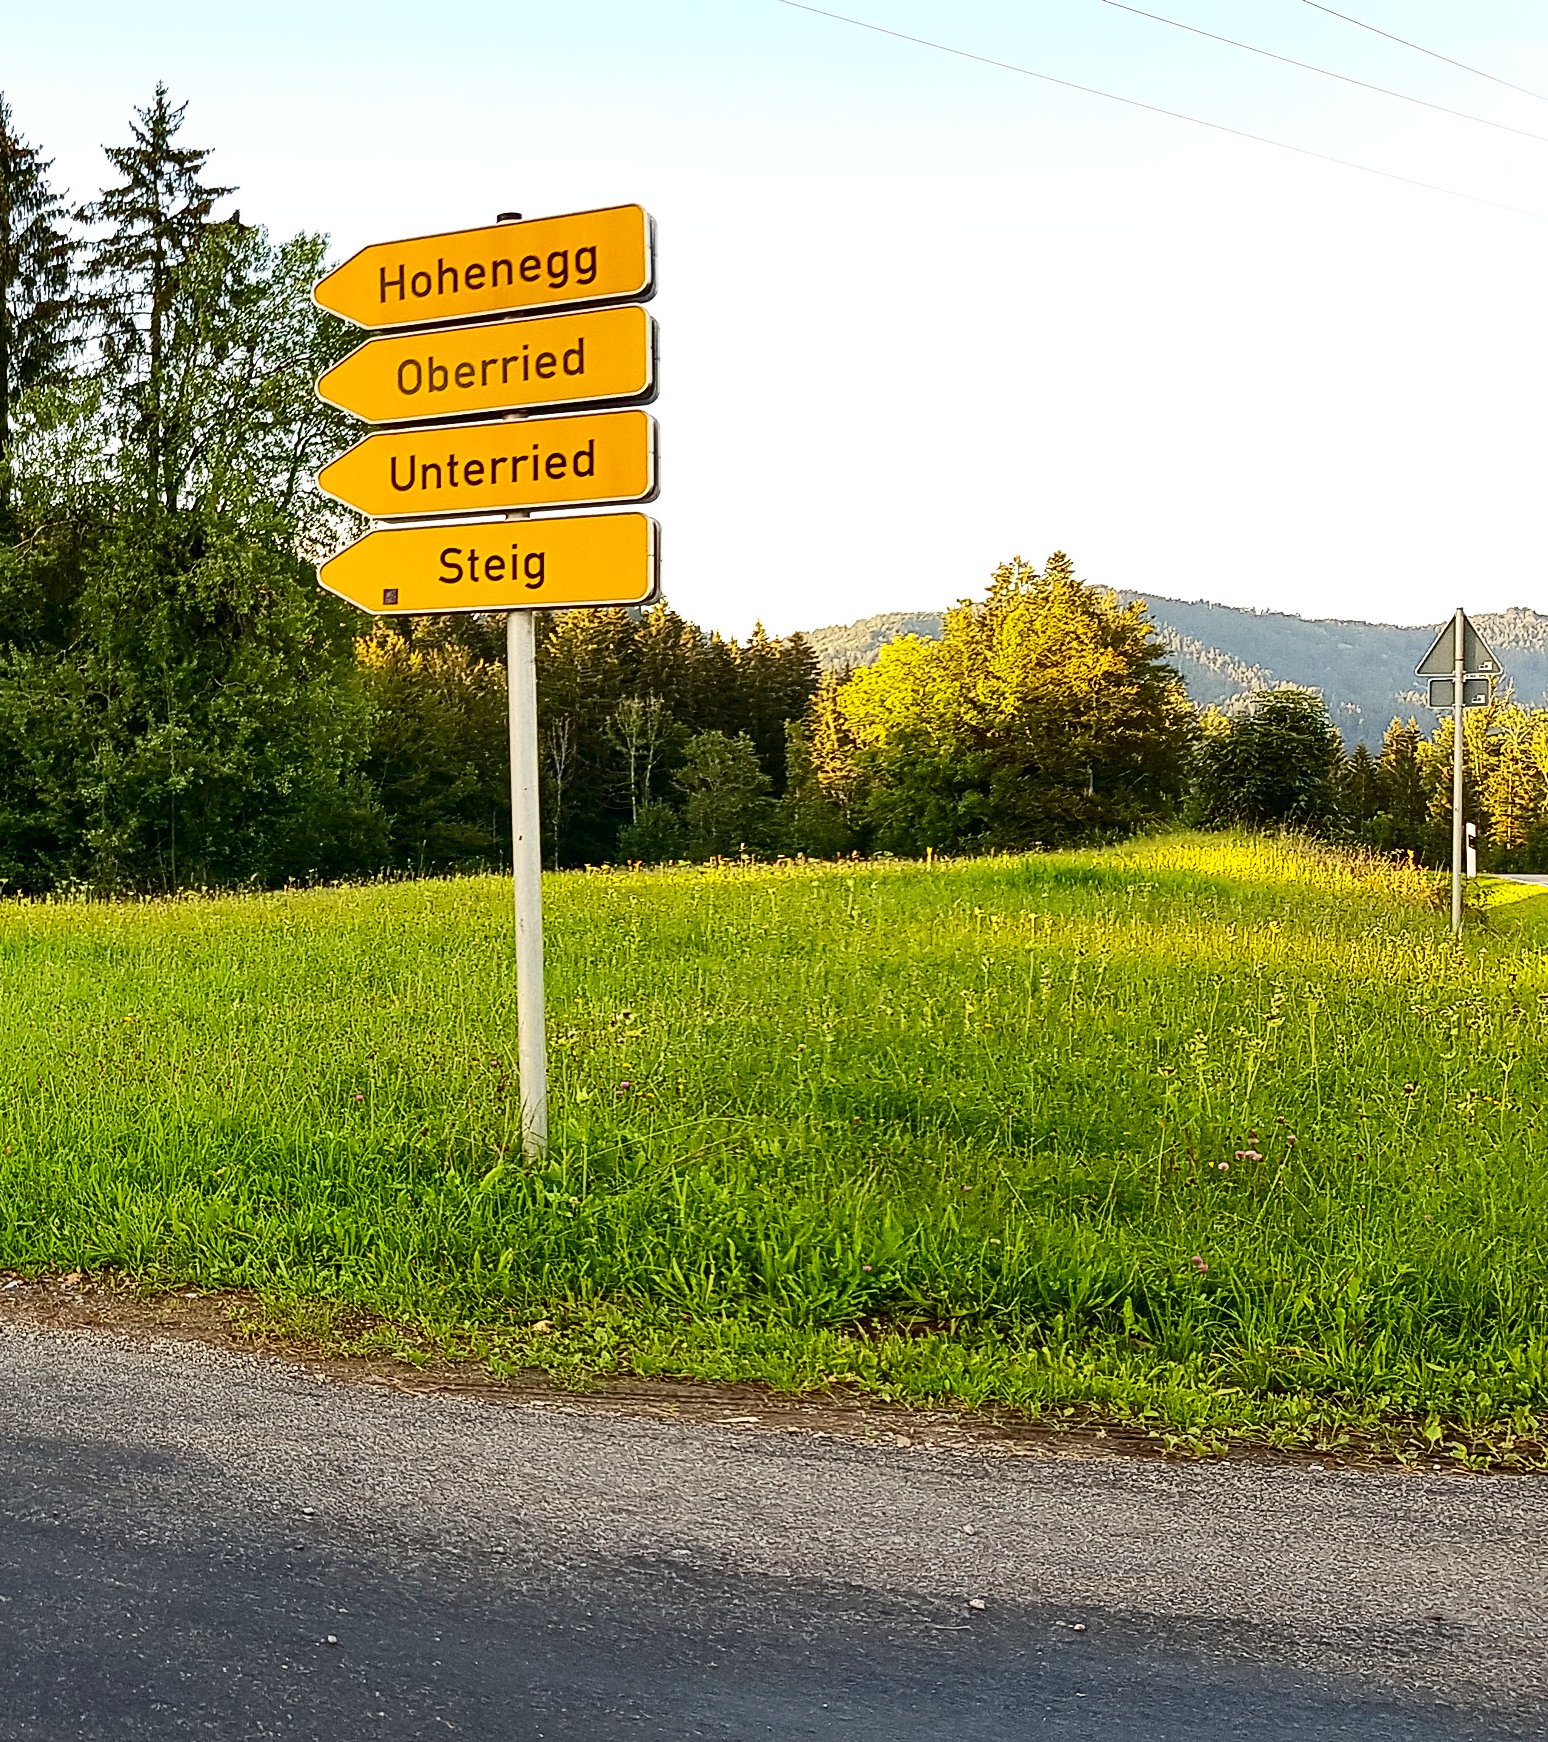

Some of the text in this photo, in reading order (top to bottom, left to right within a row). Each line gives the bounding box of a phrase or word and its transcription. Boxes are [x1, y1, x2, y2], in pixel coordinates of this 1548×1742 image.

[379, 245, 597, 304] Hohenegg
[397, 337, 585, 396] Oberried
[390, 439, 595, 492] Unterried
[438, 543, 545, 590] Steig
